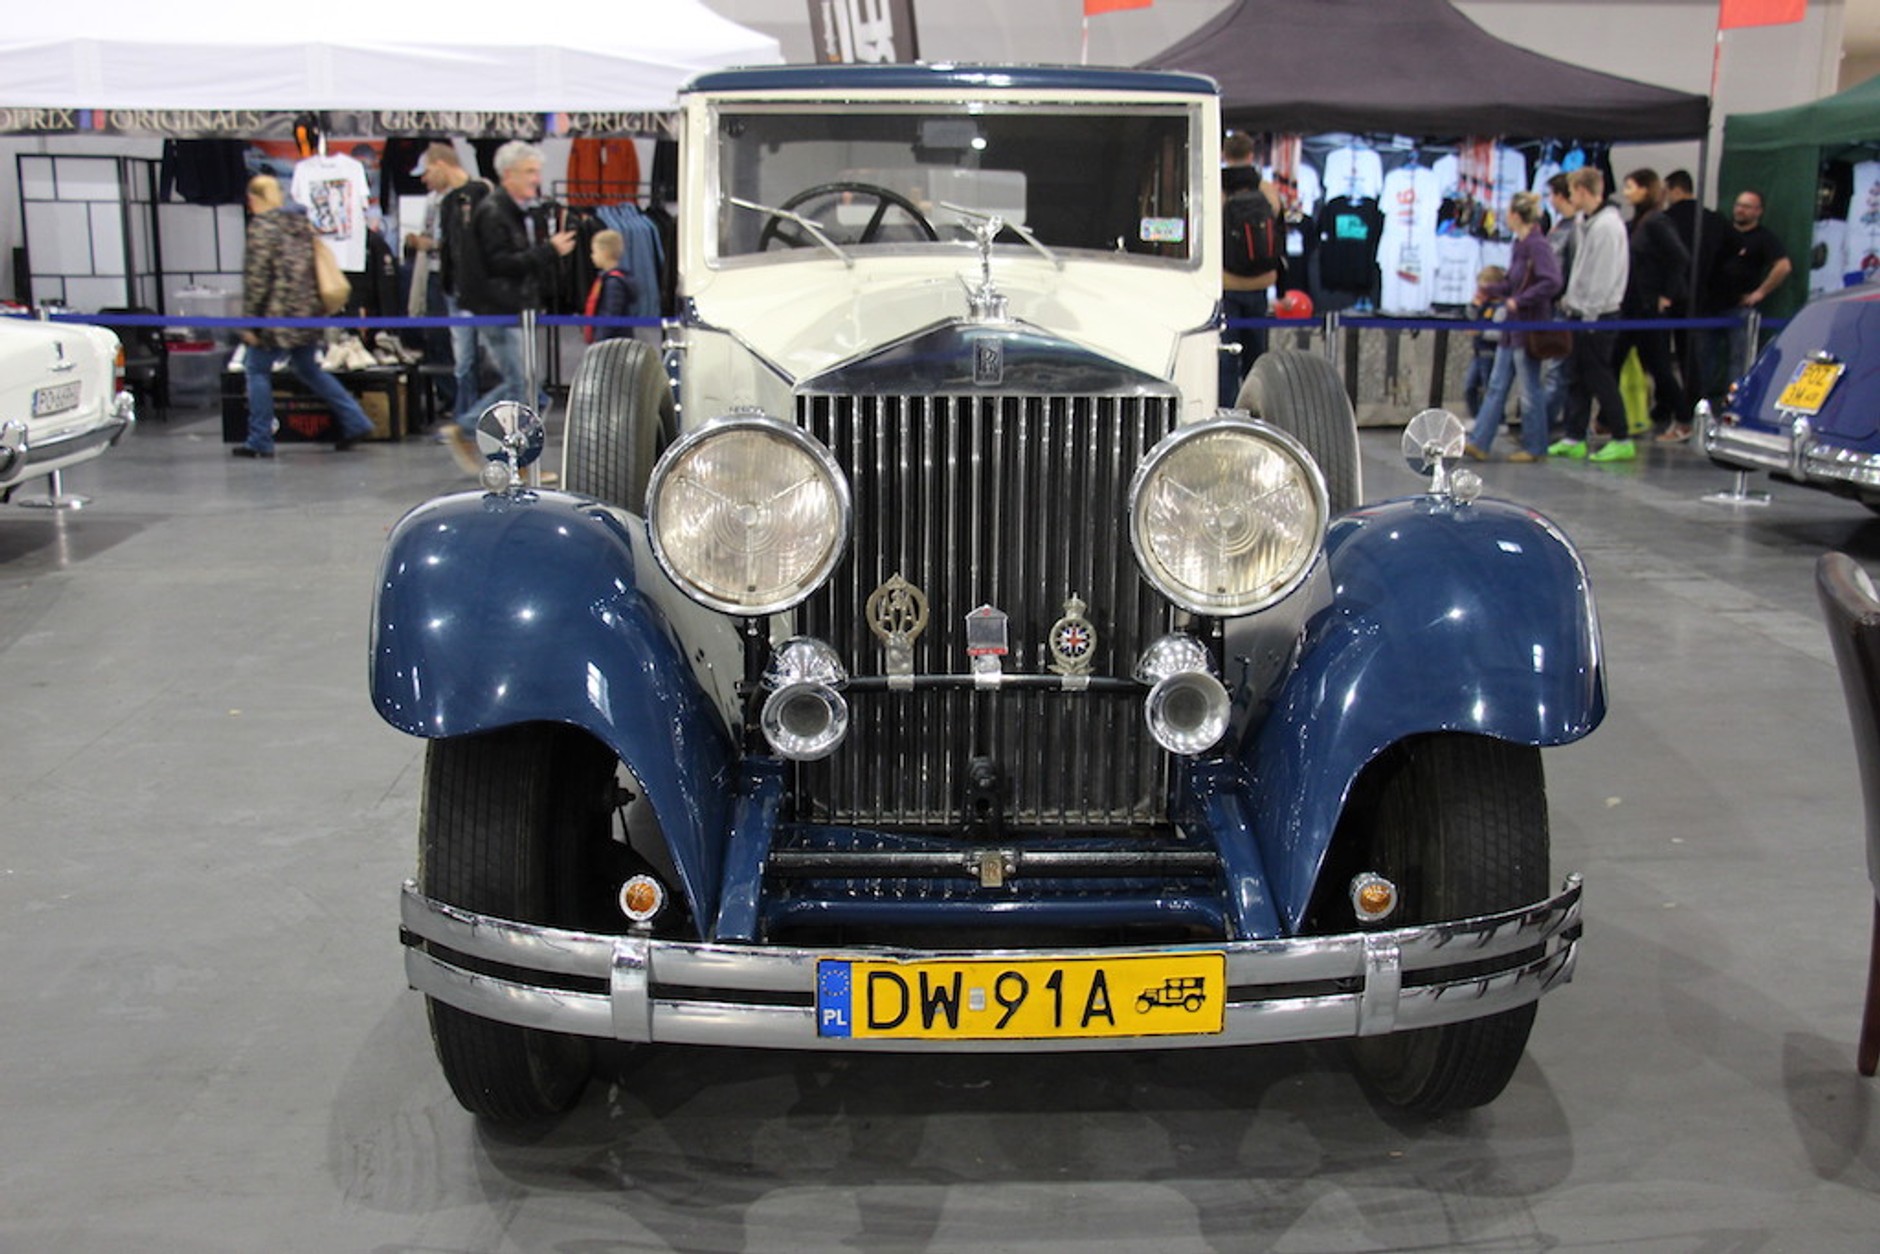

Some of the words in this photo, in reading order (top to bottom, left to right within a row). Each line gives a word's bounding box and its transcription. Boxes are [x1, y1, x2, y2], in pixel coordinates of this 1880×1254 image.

[110, 109, 261, 131] ORIGINALS
[866, 970, 963, 1030] DW
[994, 968, 1116, 1029] 91A
[822, 1009, 848, 1026] PL
